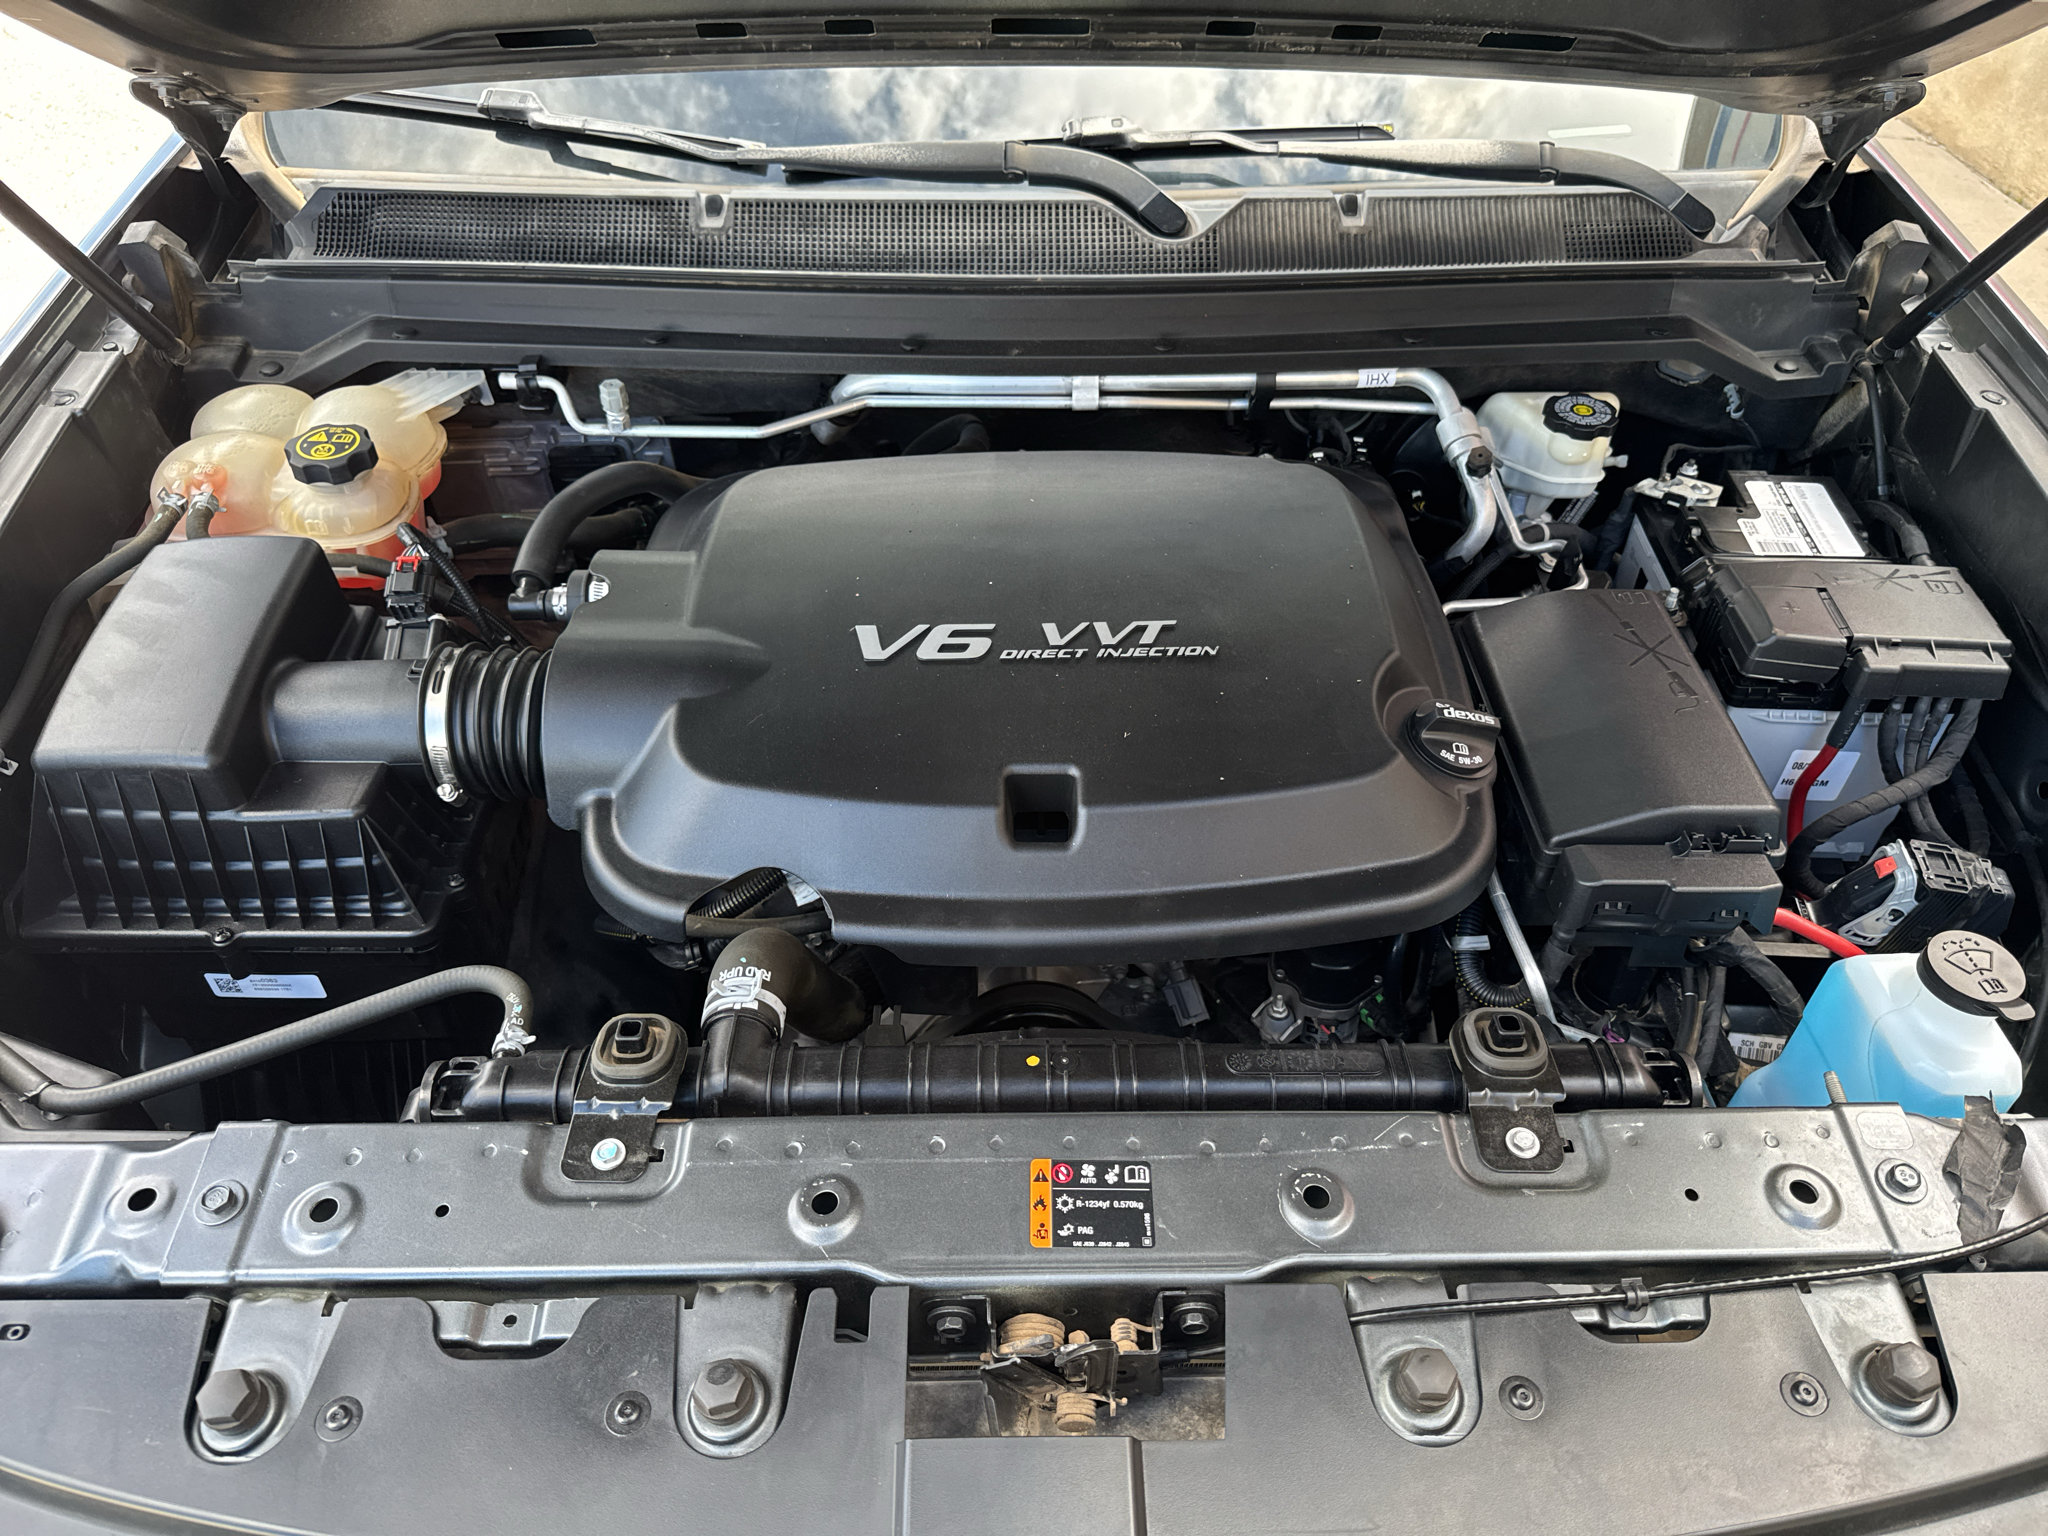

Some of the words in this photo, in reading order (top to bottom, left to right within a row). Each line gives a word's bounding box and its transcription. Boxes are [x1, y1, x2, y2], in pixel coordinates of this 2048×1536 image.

[854, 623, 997, 662] V6
[1041, 619, 1178, 646] VVT
[999, 648, 1089, 660] DIRECT
[1096, 645, 1220, 659] INJECTION
[1443, 706, 1496, 725] dexos
[1440, 749, 1456, 762] SAE
[1458, 755, 1483, 765] 5W-30
[718, 966, 744, 982] UPR
[1740, 1039, 1755, 1047] SCH
[1076, 1200, 1110, 1209] R-1234yf
[1113, 1200, 1144, 1210] 0.570kg
[1077, 1226, 1094, 1235] PAG
